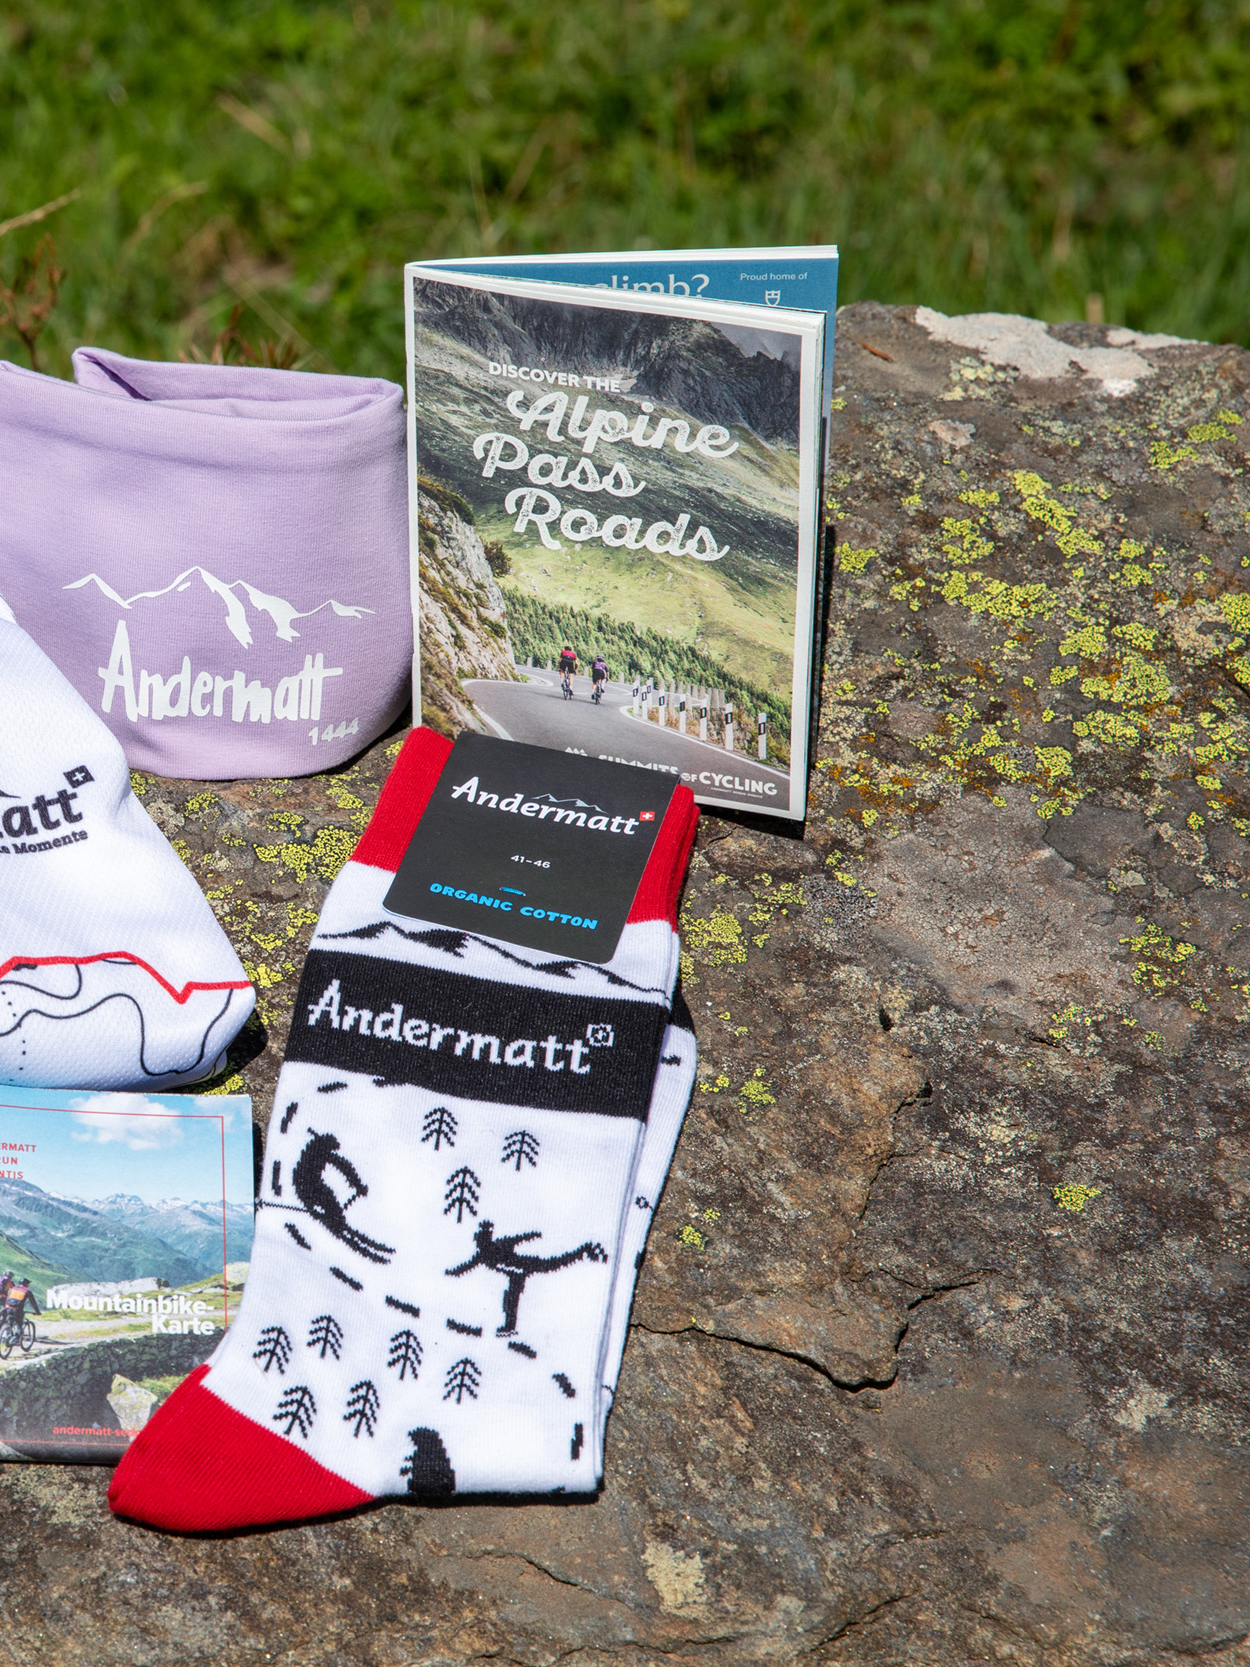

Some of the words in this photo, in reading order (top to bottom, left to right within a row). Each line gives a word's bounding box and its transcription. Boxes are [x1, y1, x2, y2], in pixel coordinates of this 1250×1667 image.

[740, 272, 768, 281] Proud
[769, 272, 796, 281] home
[798, 271, 808, 281] of
[488, 361, 580, 388] DISCOVER
[582, 375, 621, 394] THE
[506, 390, 739, 458] Alpine
[472, 432, 646, 498] Pass
[504, 487, 730, 561] Roads
[98, 619, 344, 724] Andermatt
[308, 716, 359, 746] 1444
[698, 771, 779, 797] CYCLING
[450, 776, 640, 835] Andermatt
[12, 829, 89, 854] Momente
[429, 882, 514, 911] ORGANIC
[519, 905, 599, 930] COTTON
[307, 979, 592, 1075] Andermatt
[46, 1289, 215, 1316] Mountainbike-
[150, 1314, 216, 1336] Karte
